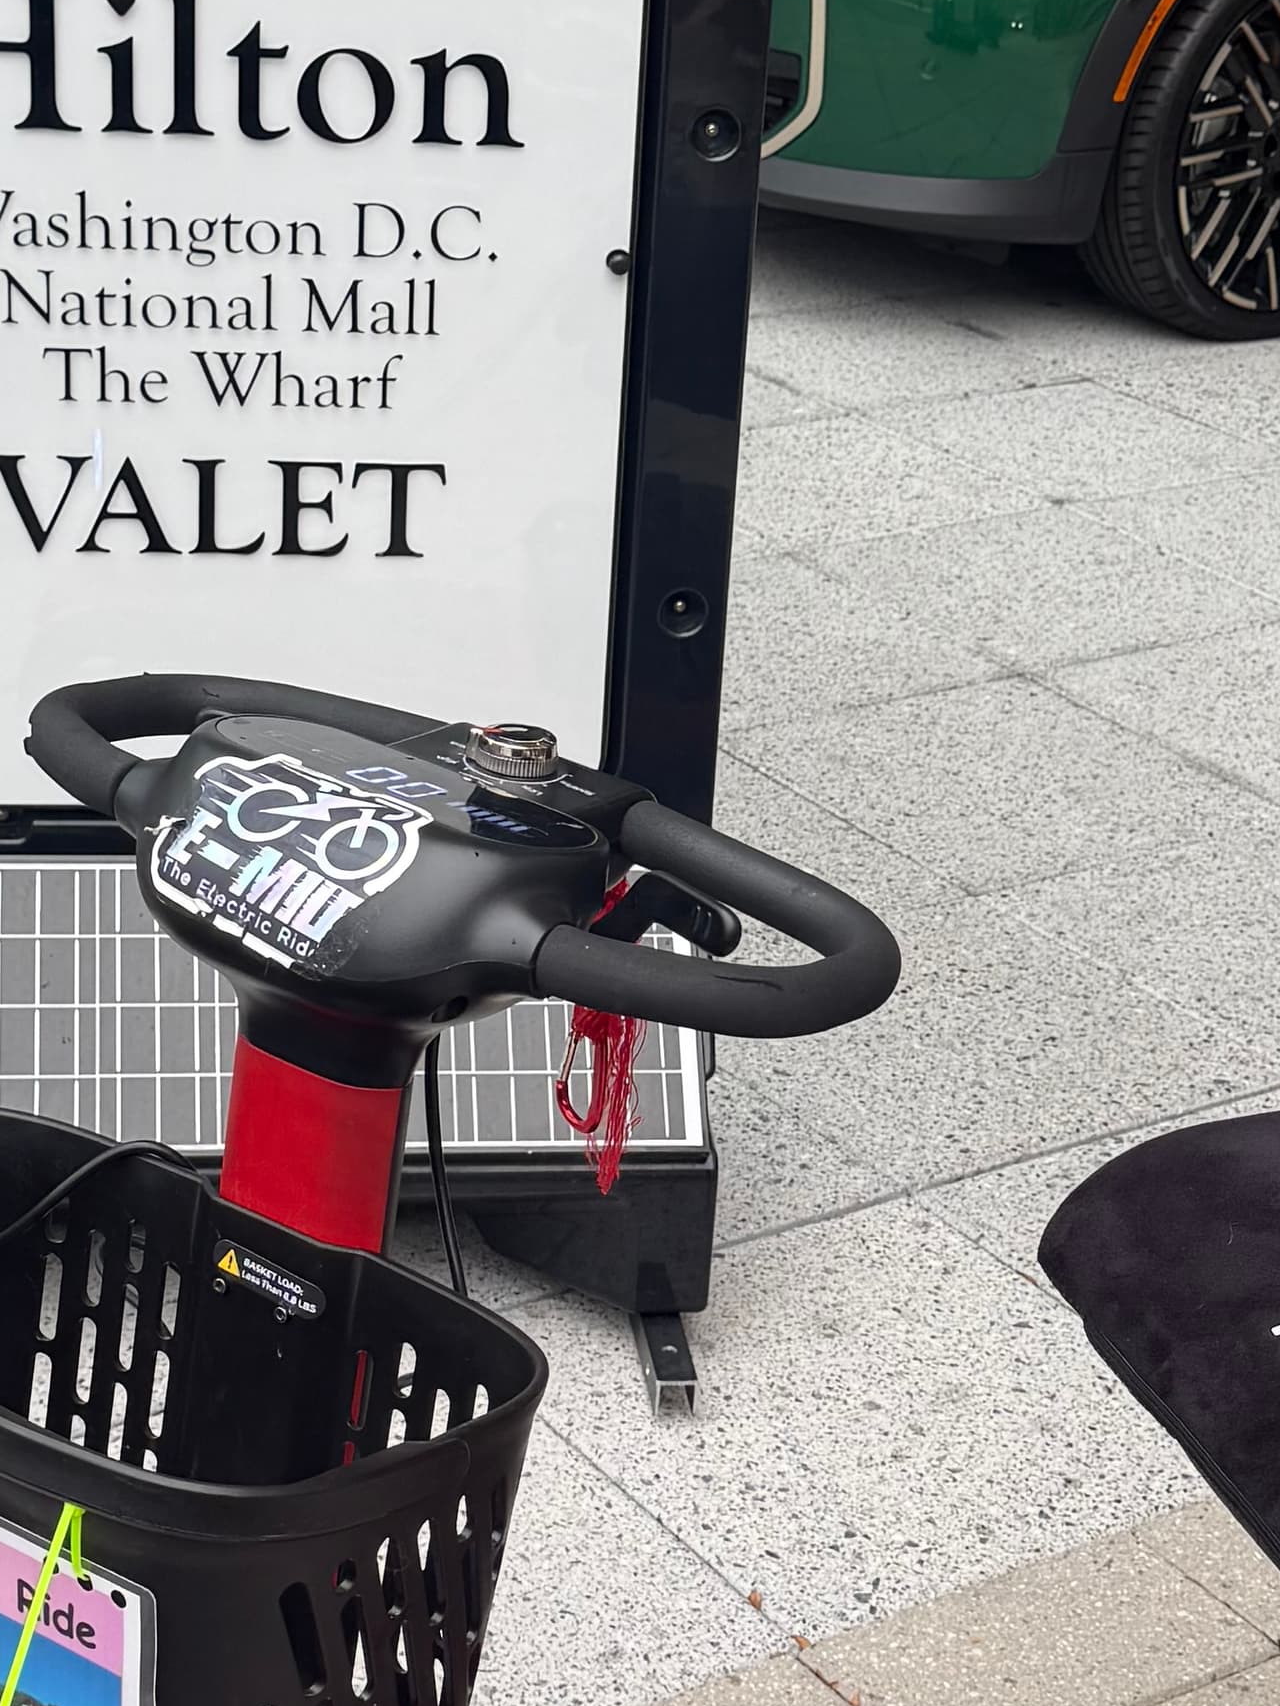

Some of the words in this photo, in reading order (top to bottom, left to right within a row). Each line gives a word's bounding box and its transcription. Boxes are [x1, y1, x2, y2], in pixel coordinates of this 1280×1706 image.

[353, 202, 499, 263] D.C.
[301, 277, 440, 336] Mall
[43, 346, 169, 405] The
[191, 351, 403, 410] Wharf
[161, 855, 190, 886] The
[196, 878, 272, 935] Electric
[241, 1270, 261, 1286] Less
[261, 1280, 282, 1297] Than
[297, 1299, 317, 1314] LBS
[243, 1258, 278, 1282] BASKET
[277, 1276, 304, 1296] LOAD:
[16, 1578, 96, 1650] Ride
